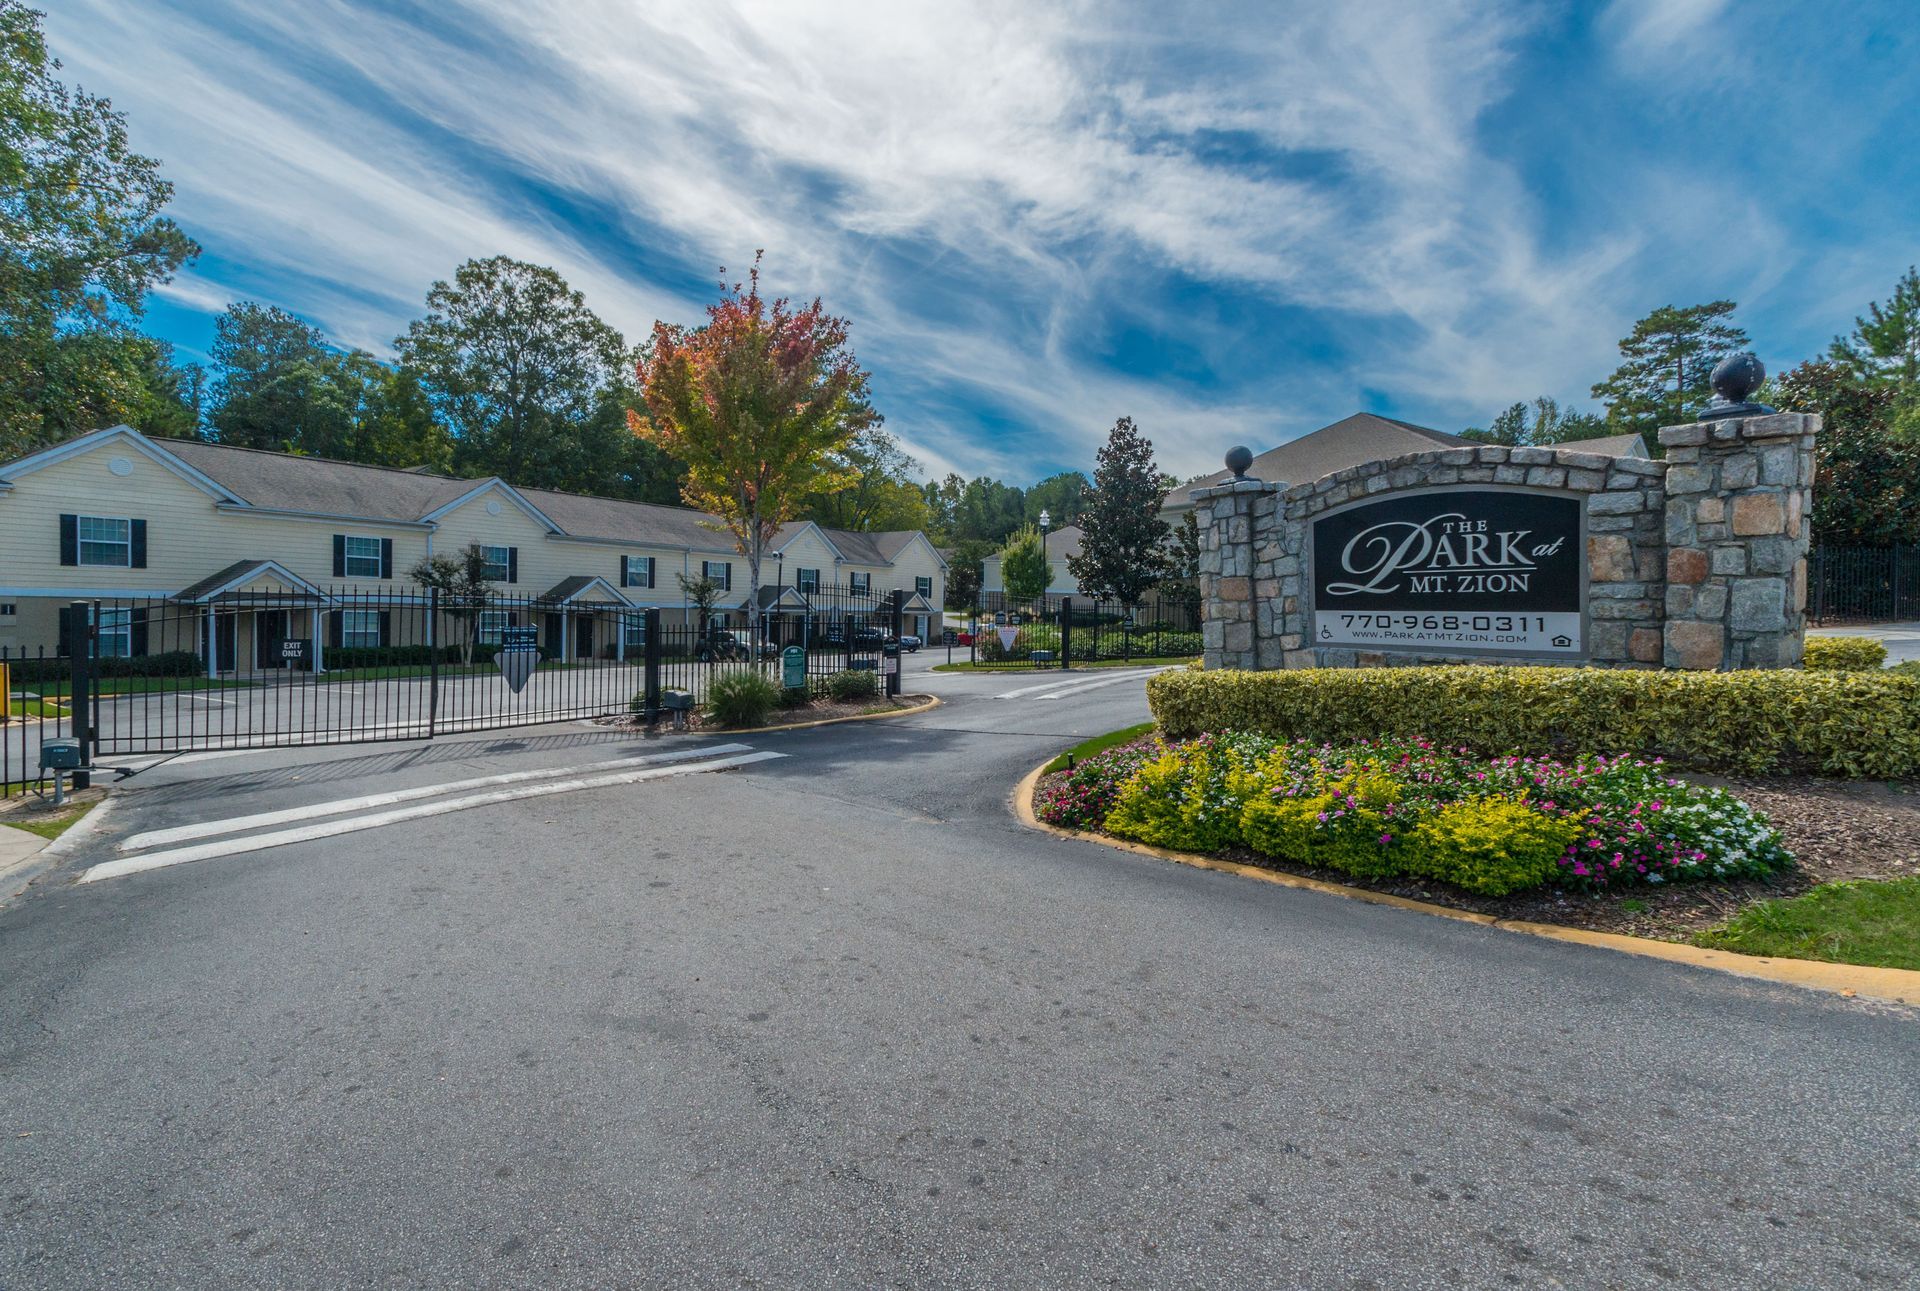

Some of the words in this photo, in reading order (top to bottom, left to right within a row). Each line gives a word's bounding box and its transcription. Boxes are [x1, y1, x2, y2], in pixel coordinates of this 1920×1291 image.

[1443, 520, 1488, 533] THE
[1326, 513, 1535, 595] PARK
[1532, 536, 1565, 557] at
[1409, 575, 1452, 593] MT.
[1457, 573, 1530, 593] ZION
[1341, 614, 1544, 632] 770-968-0311
